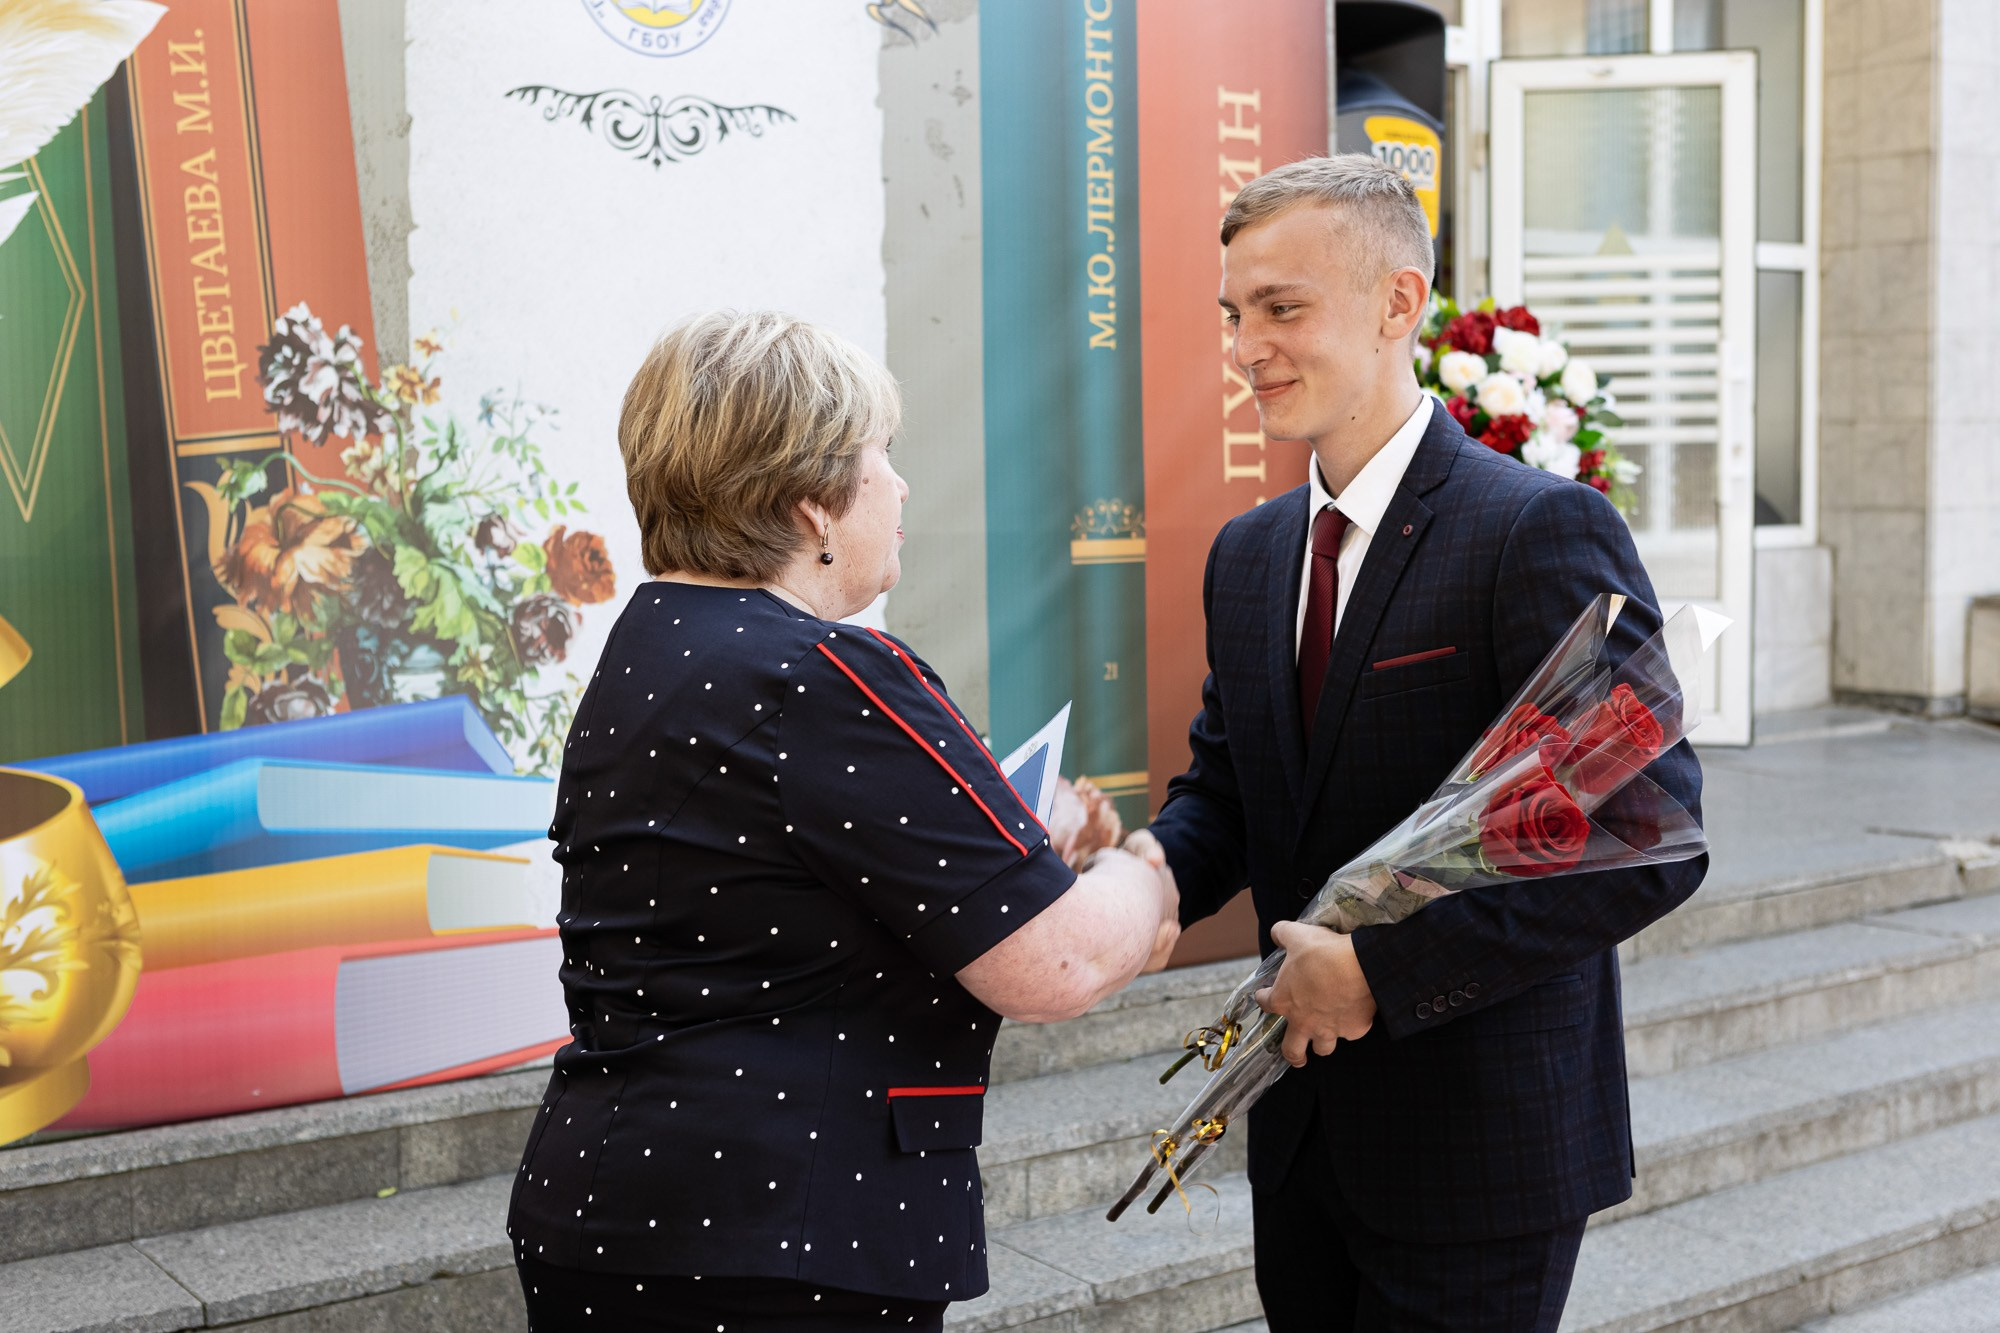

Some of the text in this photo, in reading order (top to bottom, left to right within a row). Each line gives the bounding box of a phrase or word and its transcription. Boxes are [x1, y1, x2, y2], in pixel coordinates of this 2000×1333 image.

[628, 27, 680, 49] ГБОУ
[1379, 145, 1435, 176] 1000
[168, 28, 248, 402] ЦВЕТАЕВА М.И.
